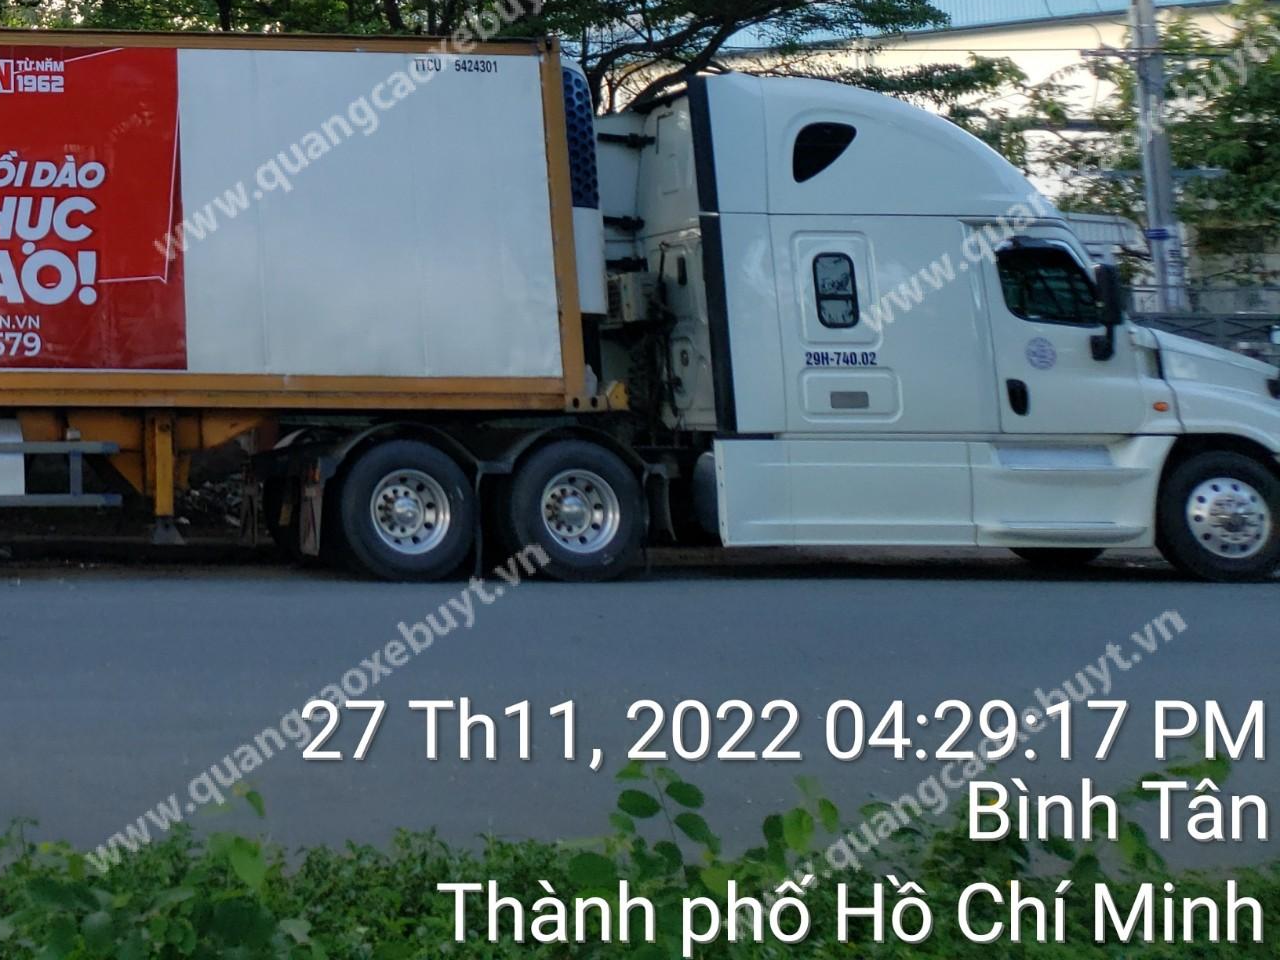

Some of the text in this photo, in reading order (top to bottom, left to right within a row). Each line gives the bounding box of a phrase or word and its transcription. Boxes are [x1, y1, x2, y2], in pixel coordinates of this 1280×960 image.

[454, 60, 498, 73] 5424301
[16, 75, 65, 92] 1962
[30, 155, 106, 189] DÀO
[805, 351, 877, 366] 29H-740.02
